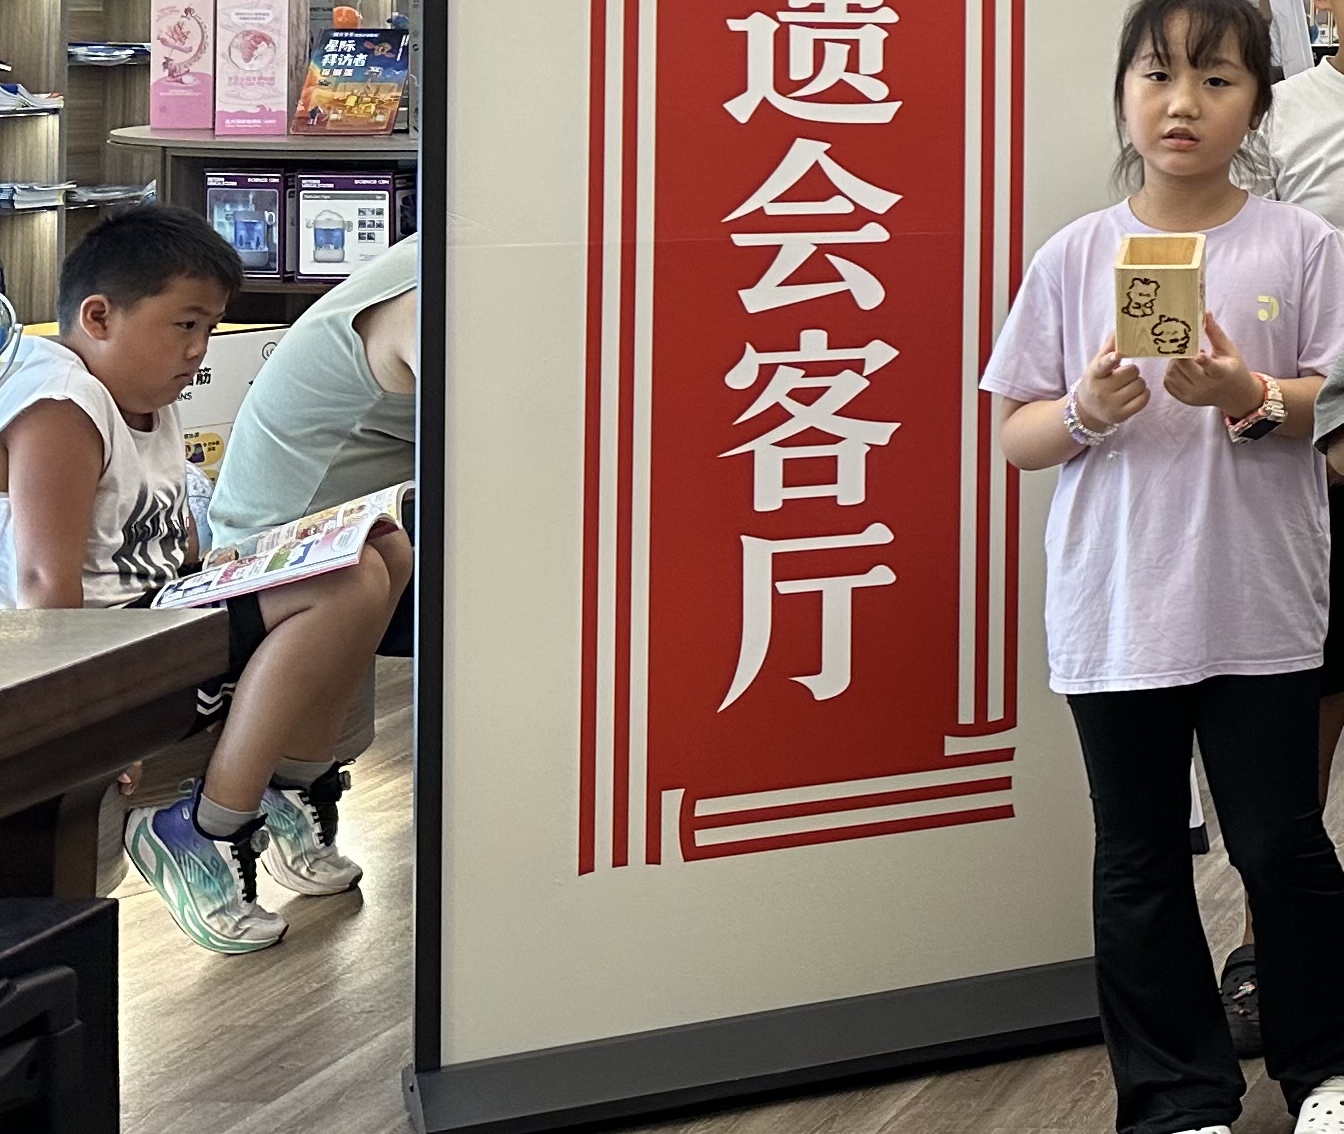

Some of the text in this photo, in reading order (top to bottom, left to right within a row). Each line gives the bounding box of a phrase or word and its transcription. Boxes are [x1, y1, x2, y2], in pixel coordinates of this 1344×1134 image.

[325, 39, 356, 53] 星际
[321, 53, 368, 67] 拜访者
